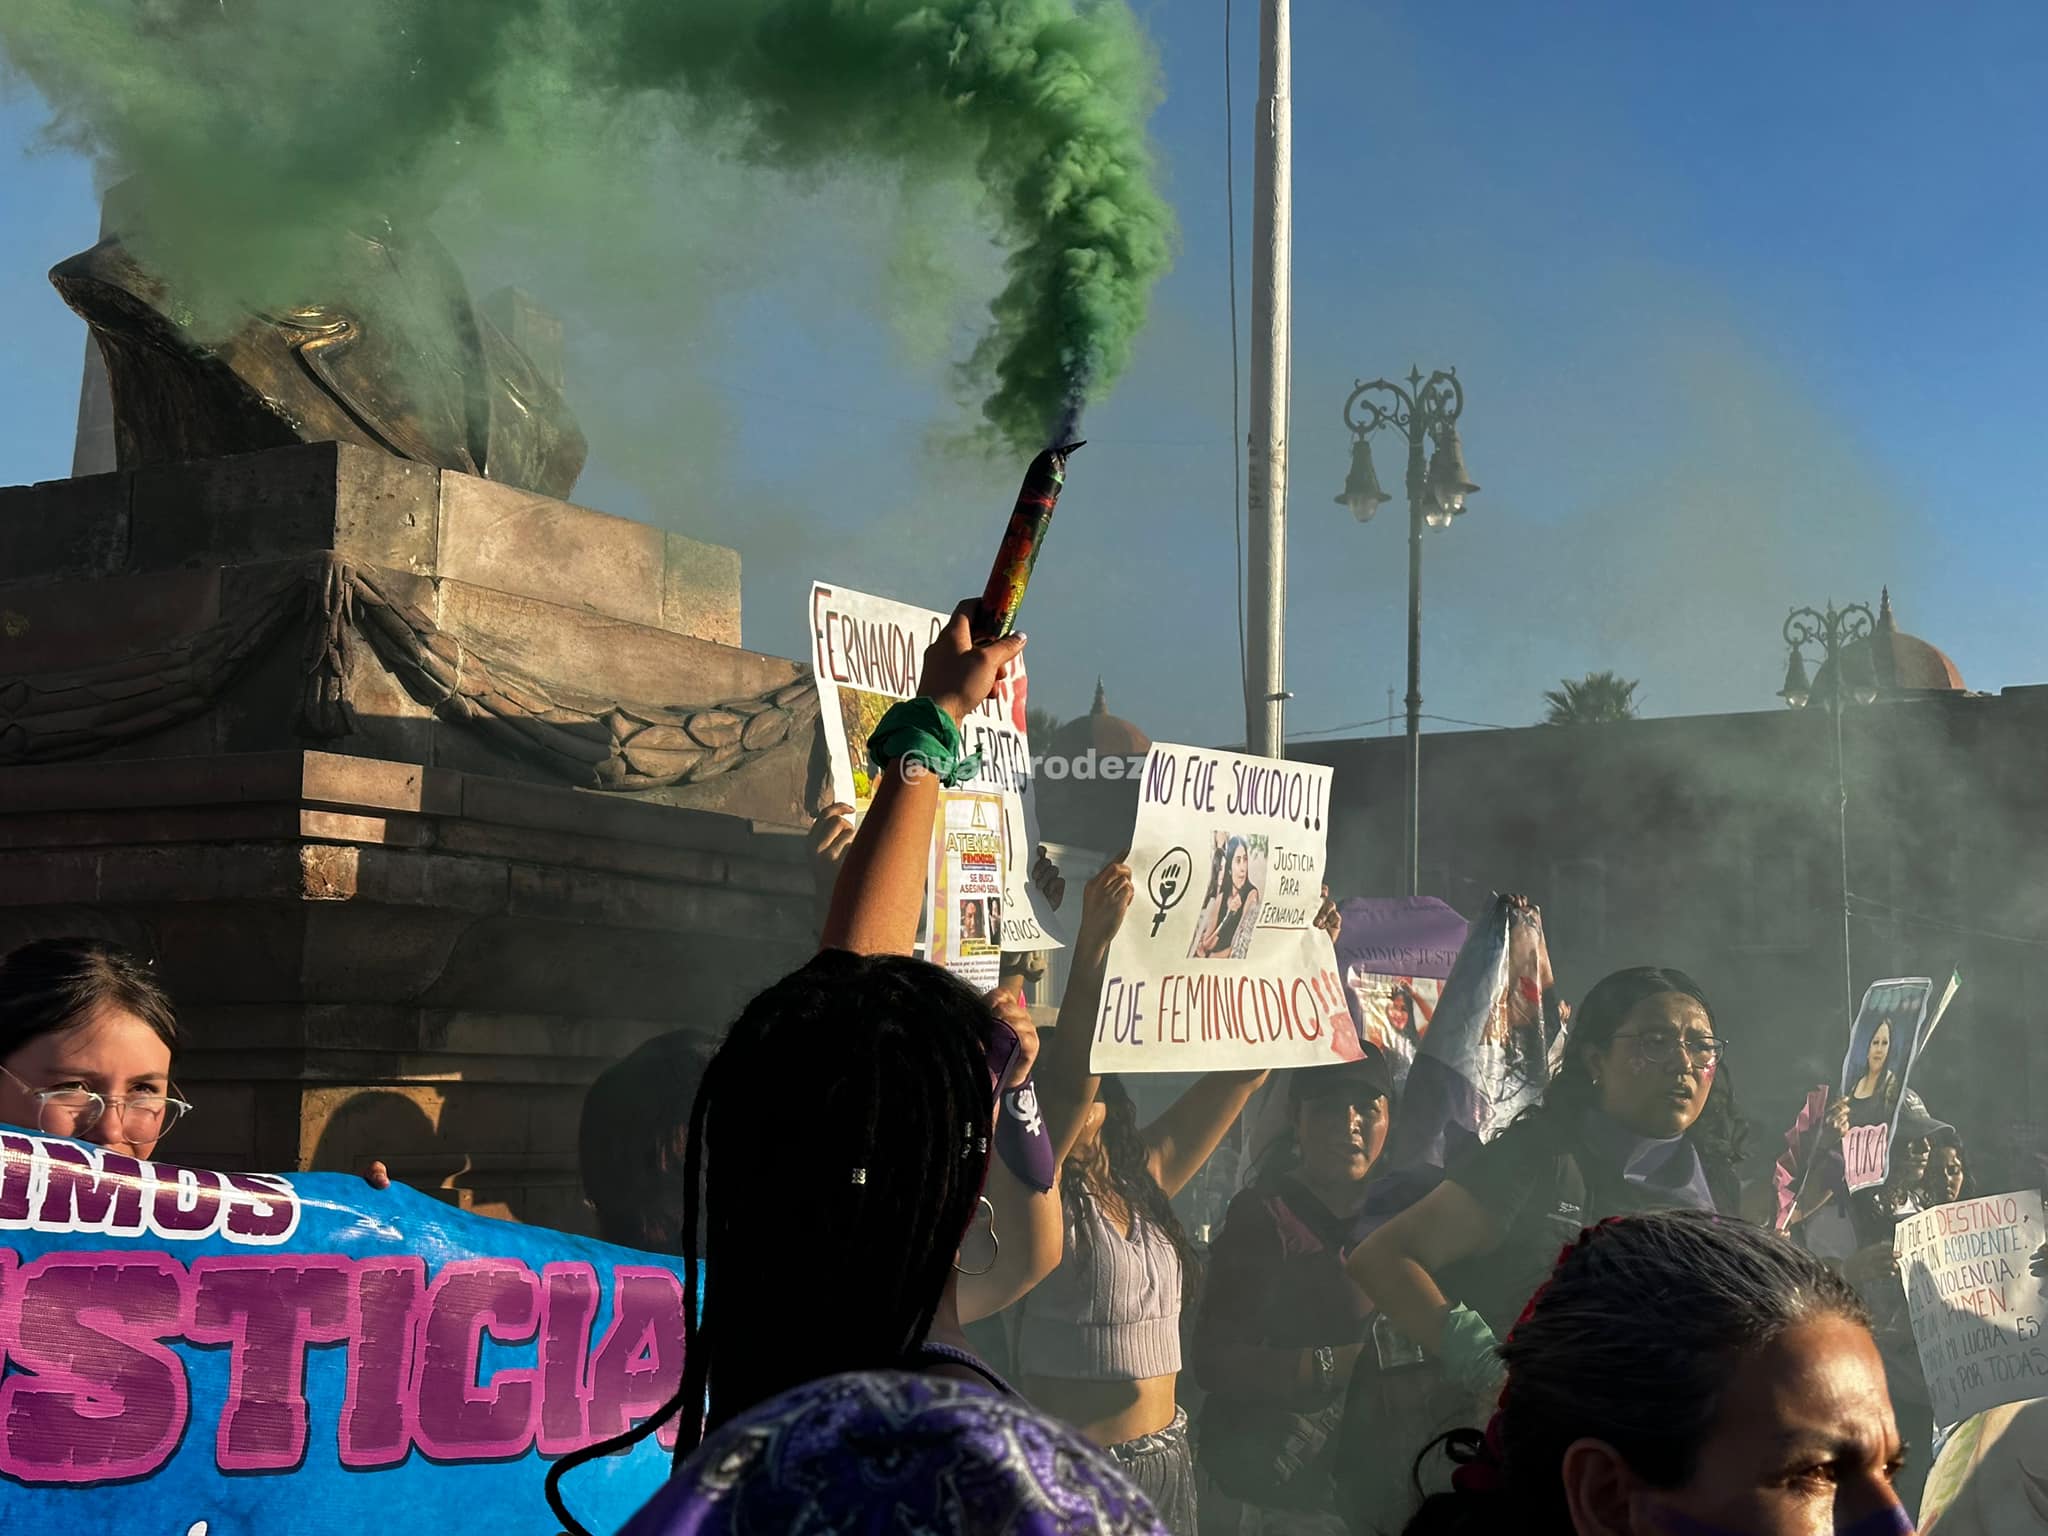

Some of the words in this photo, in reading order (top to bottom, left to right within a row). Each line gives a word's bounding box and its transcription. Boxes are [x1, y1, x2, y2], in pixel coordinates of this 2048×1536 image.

[813, 586, 917, 698] FERNANDA
[1145, 749, 1176, 804] NO
[1182, 755, 1218, 812] FUE
[1227, 760, 1322, 831] SUICIDIO!!
[1274, 846, 1315, 872] JUSTICIA
[1278, 876, 1300, 897] PARA
[1258, 902, 1305, 925] FERNANDA
[1098, 976, 1145, 1045] FUE
[1908, 1221, 1922, 1249] FUE
[1961, 1324, 2008, 1356] LUCHA
[2015, 1315, 2041, 1342] ES
[0, 1248, 689, 1482] STICIA
[1957, 1361, 1985, 1393] POR
[1984, 1346, 2048, 1383] TODAS
